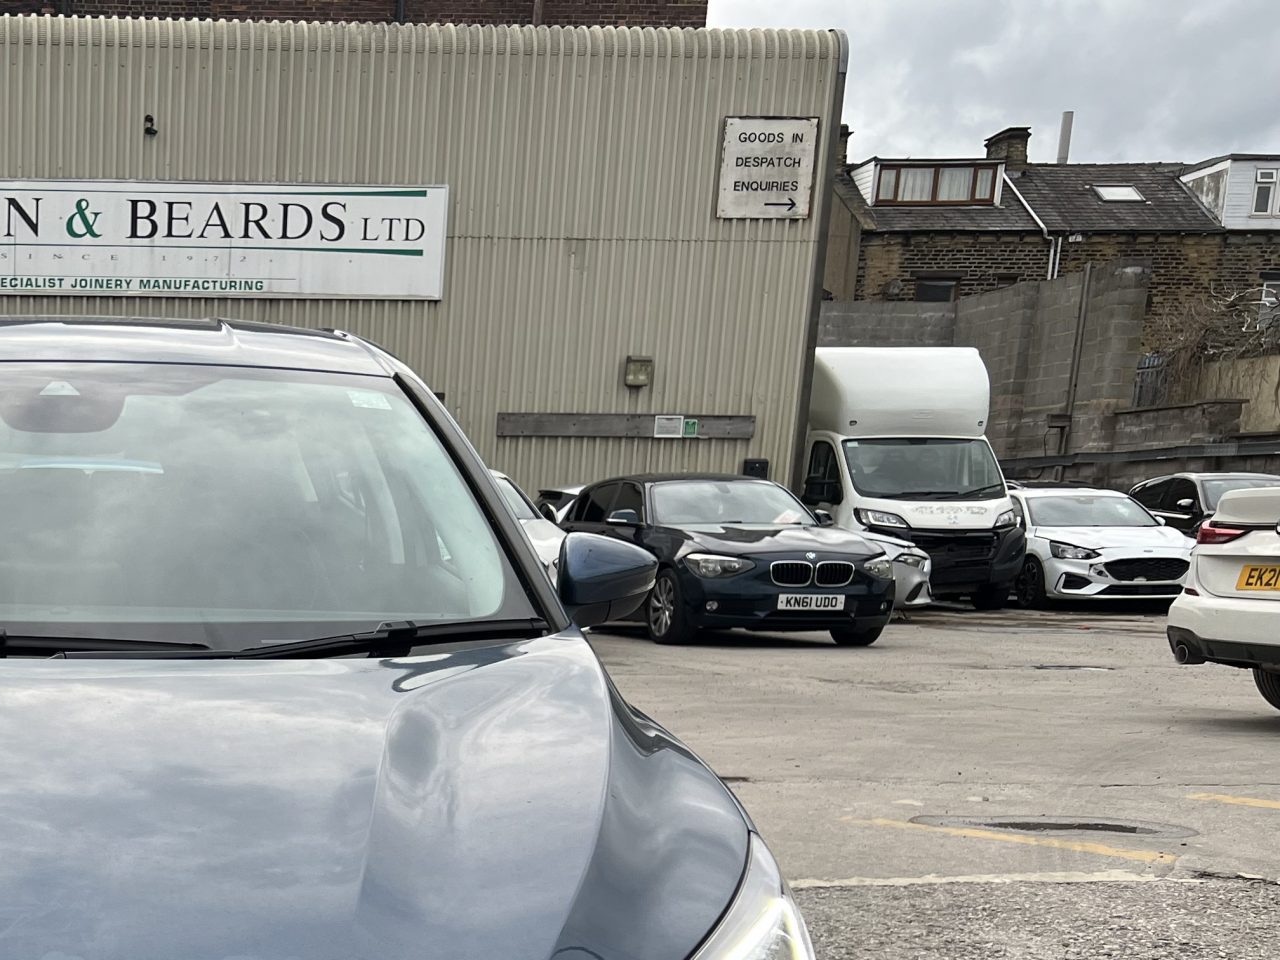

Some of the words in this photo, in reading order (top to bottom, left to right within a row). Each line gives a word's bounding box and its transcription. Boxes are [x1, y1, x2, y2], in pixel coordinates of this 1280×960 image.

[738, 132, 784, 143] GOODS
[792, 133, 804, 143] IN
[735, 157, 801, 167] DESPATCH
[733, 180, 799, 191] ENQUIRIES
[66, 198, 103, 238] &
[125, 198, 347, 242] BEARDS
[360, 217, 426, 242] LTD
[0, 252, 119, 261] SINCE
[70, 277, 133, 290] JOINERY
[138, 278, 265, 292] MANUFACTURING
[785, 596, 813, 608] KN61
[815, 596, 838, 608] UDO
